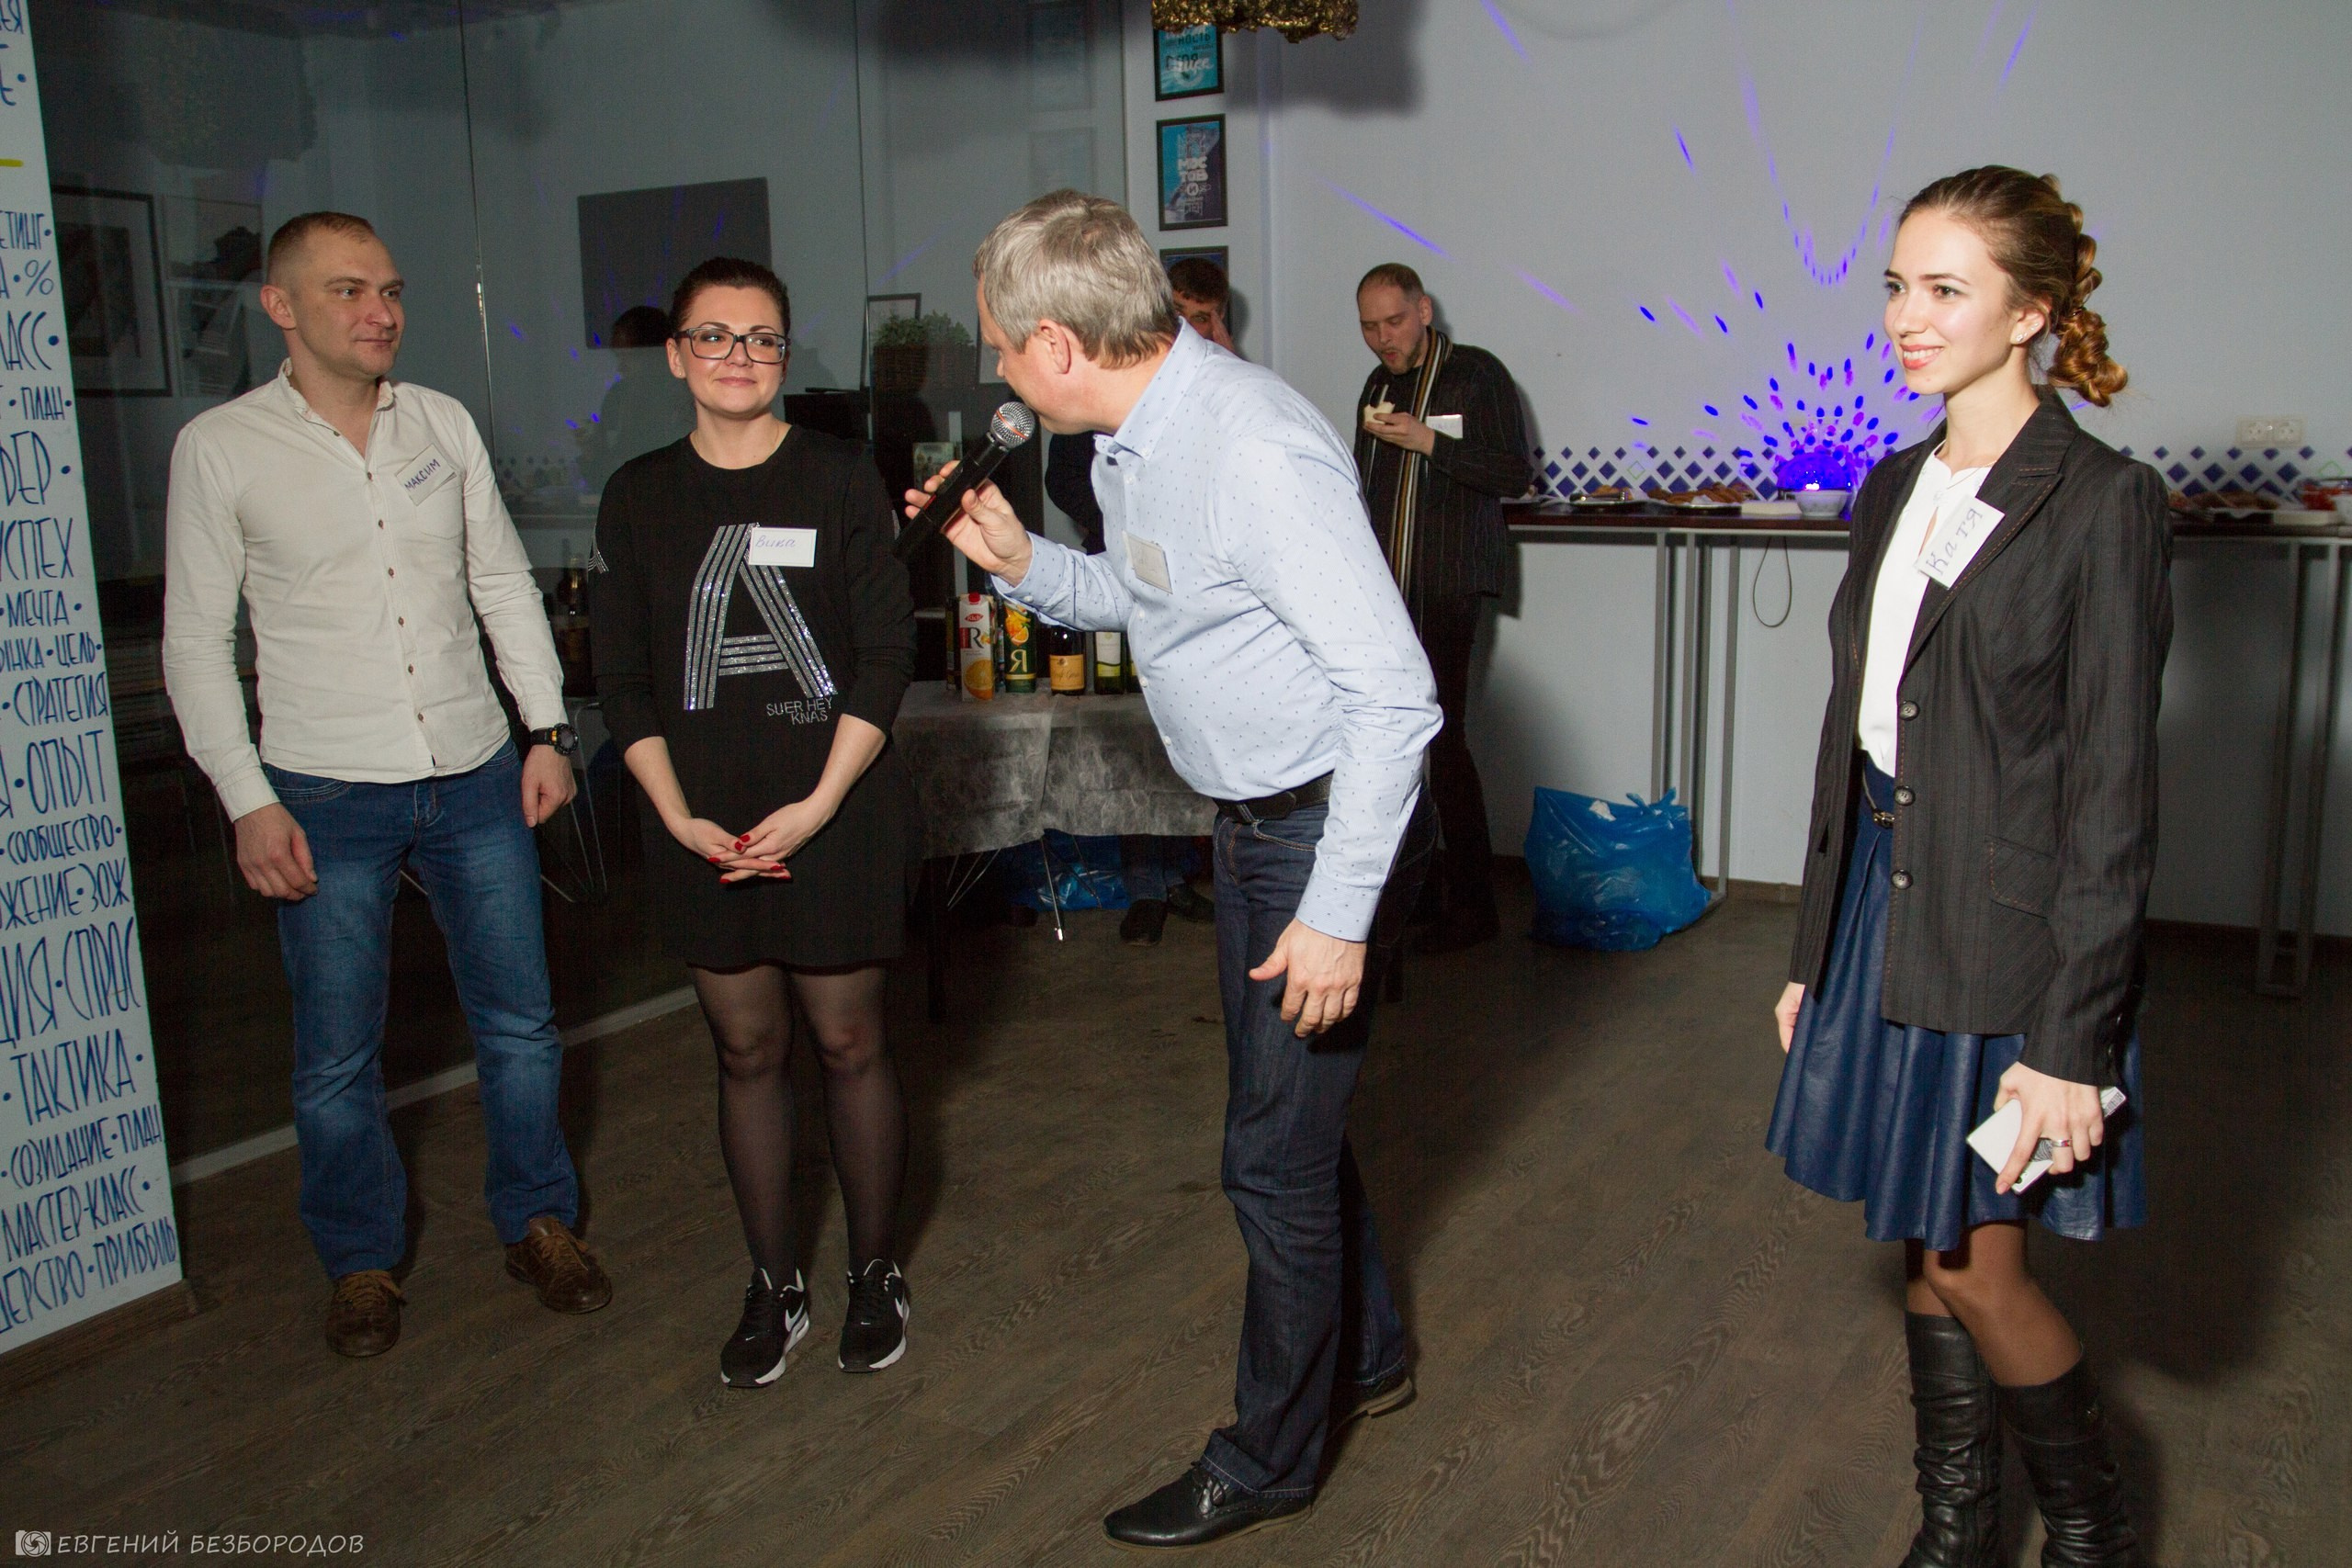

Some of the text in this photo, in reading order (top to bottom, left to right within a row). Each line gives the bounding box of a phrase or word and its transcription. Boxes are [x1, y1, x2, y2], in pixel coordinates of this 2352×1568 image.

[25, 259, 54, 297] %
[20, 386, 65, 421] ПЛАН
[404, 458, 441, 491] МАКСИМ
[0, 517, 74, 581] СПЕХ
[755, 535, 796, 547] Вика
[6, 589, 70, 627] МЕЧТА
[54, 631, 96, 668] ЦЕЛЬ
[1011, 649, 1028, 672] Я
[14, 671, 109, 726] СТРАТЕГИЯ
[766, 696, 832, 716] SUER HEY
[791, 709, 828, 726] KNAS
[27, 729, 106, 814] ОПЫТ
[7, 813, 115, 865] СООБЩЕСТВО
[78, 857, 130, 913] ЗОЖ
[62, 917, 141, 1021] СПРОС
[9, 1028, 136, 1126] ТАКТИКА
[10, 1104, 163, 1189] СОЗИДАНИЕ ПЛАН
[1, 1165, 145, 1263] МАСТЕР-КЛАСС
[93, 1216, 176, 1290] ПРИБЫЛЬ
